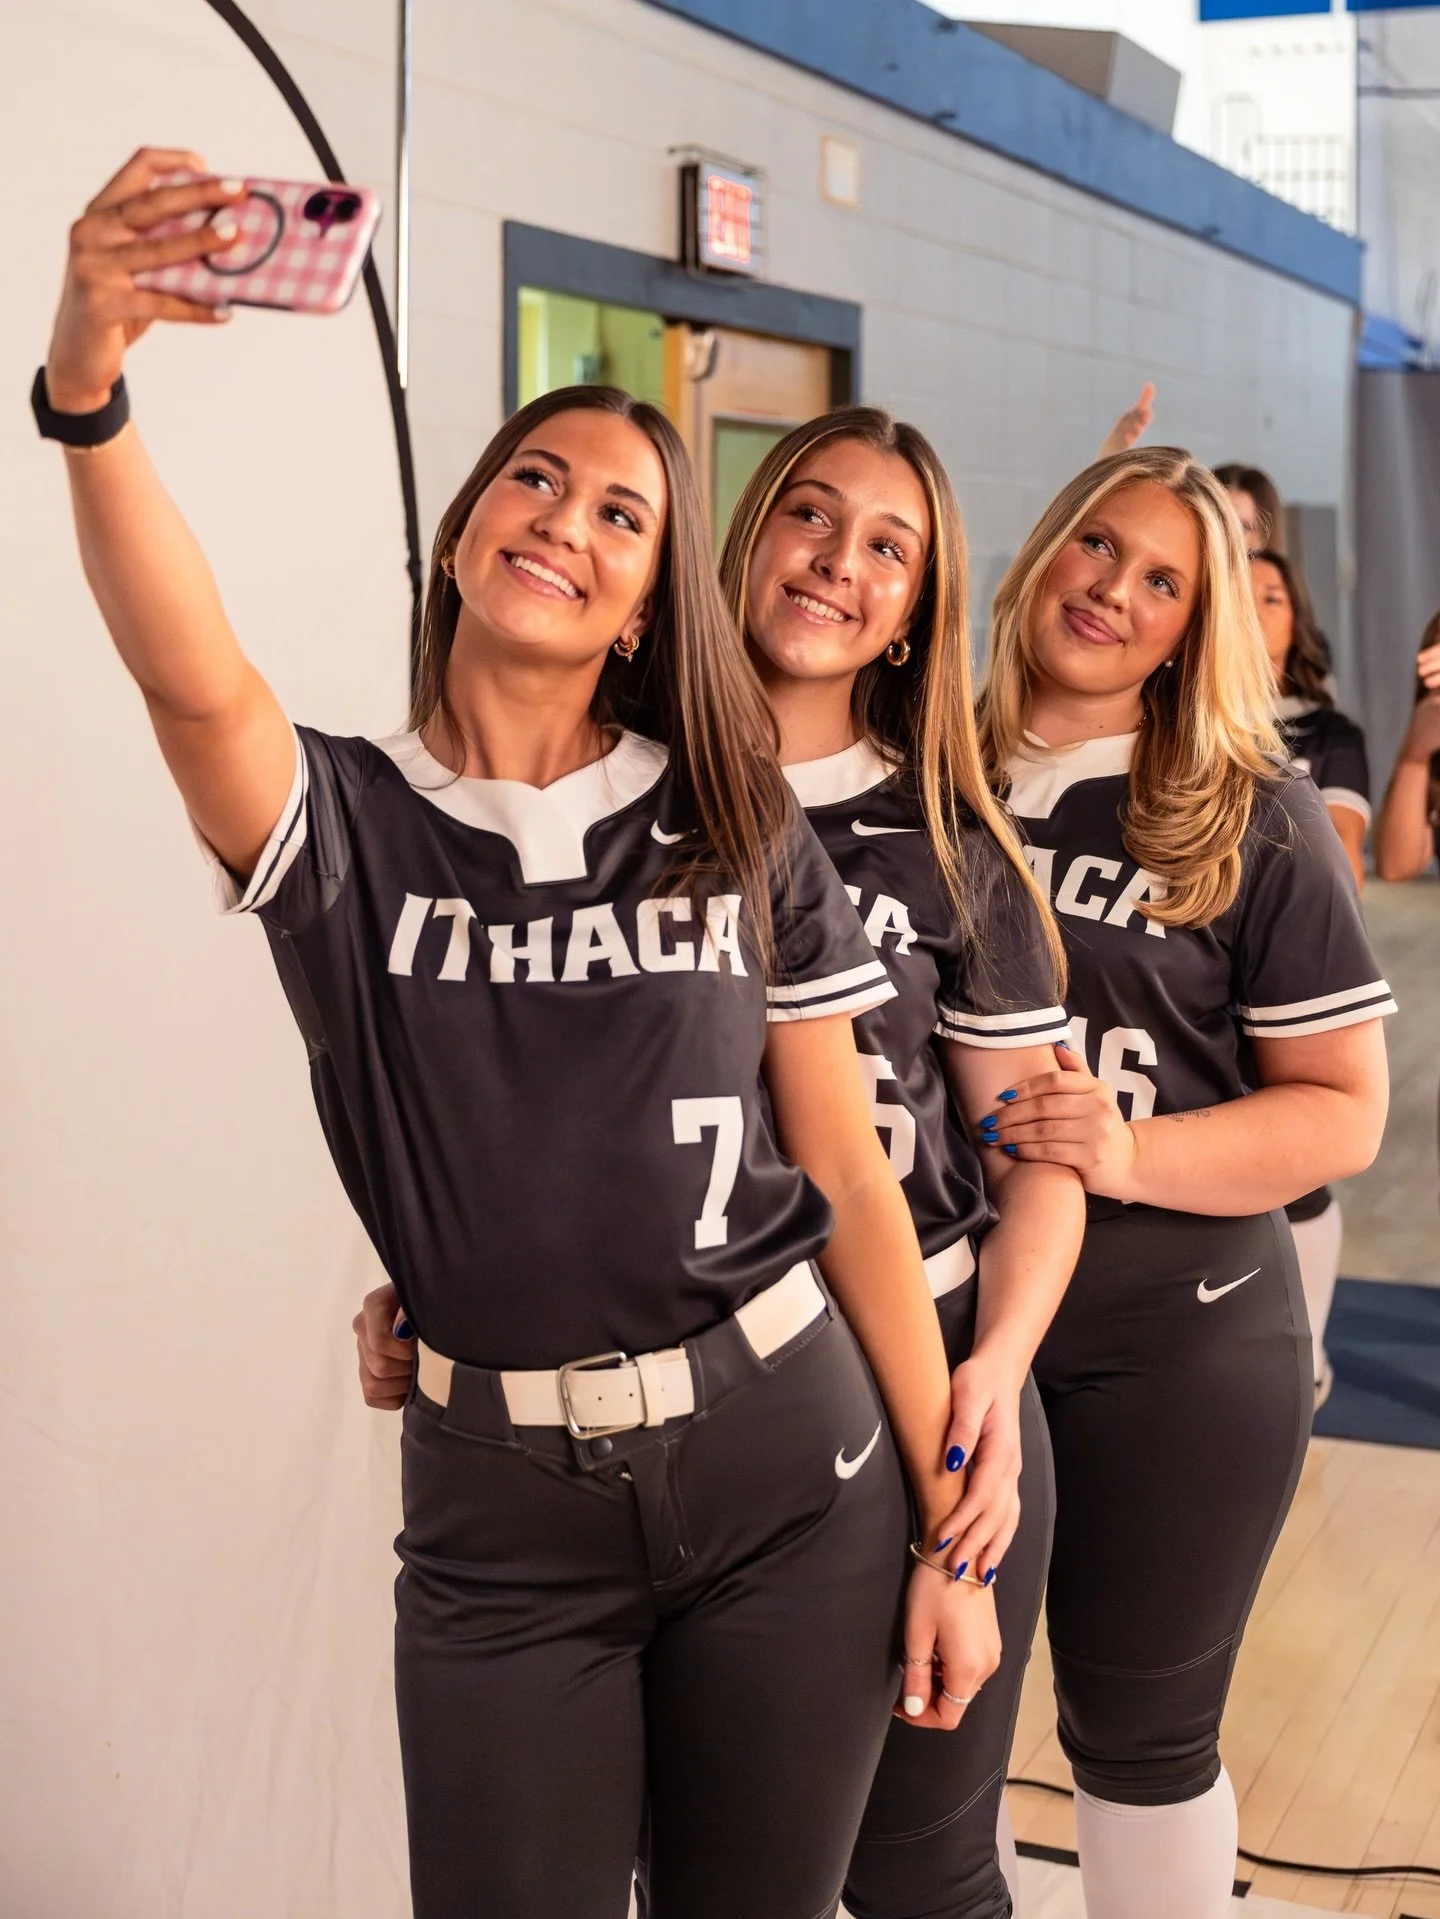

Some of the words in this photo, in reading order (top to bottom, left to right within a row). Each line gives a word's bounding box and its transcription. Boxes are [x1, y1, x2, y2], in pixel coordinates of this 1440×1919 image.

[387, 892, 749, 983] ITHACA
[843, 884, 919, 956] A
[671, 1096, 745, 1250] 7
